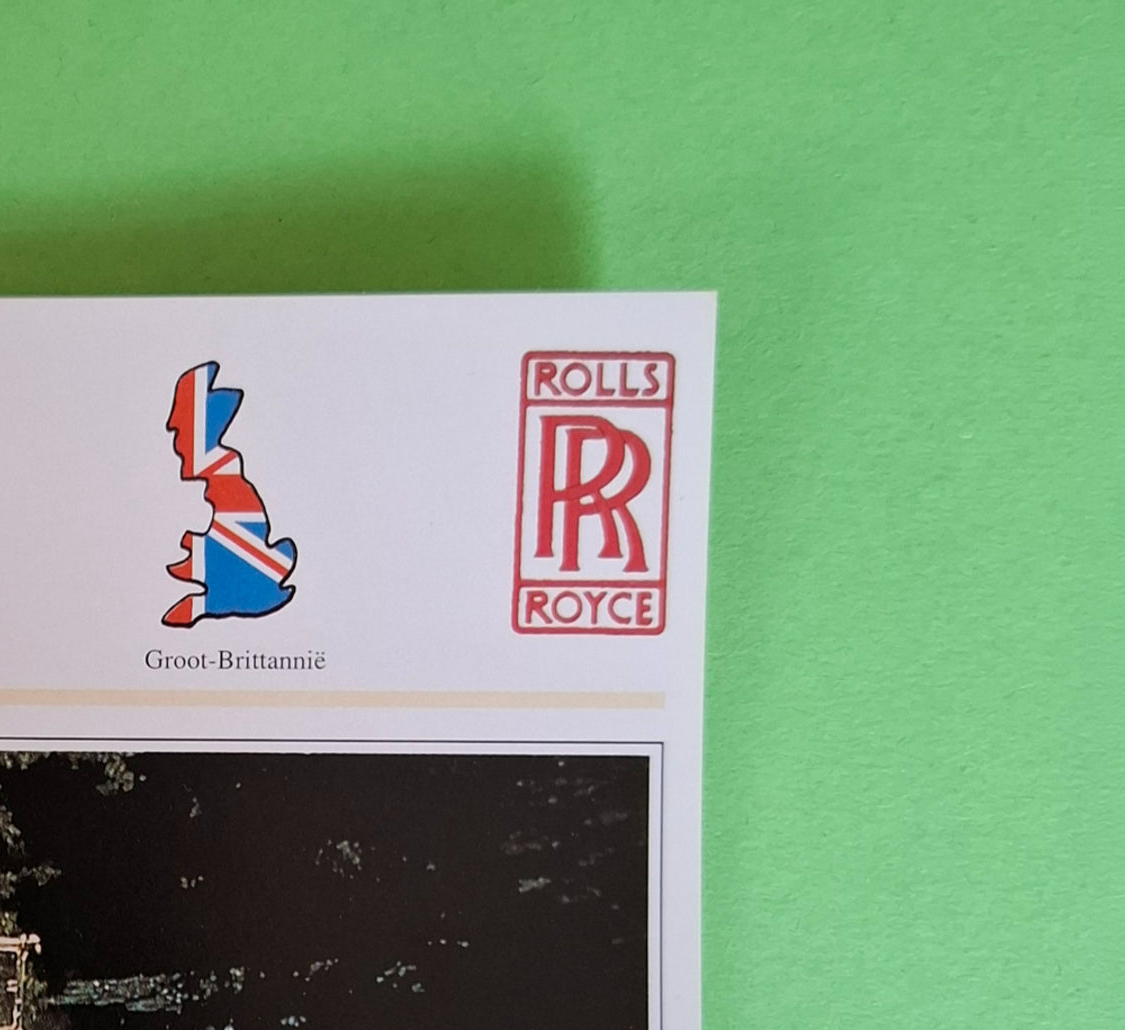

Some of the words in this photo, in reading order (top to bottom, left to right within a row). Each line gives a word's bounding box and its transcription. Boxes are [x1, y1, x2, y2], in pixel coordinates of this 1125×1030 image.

[534, 361, 661, 396] ROLLS
[524, 590, 653, 627] ROYCE
[144, 649, 327, 672] Groot-Brittannië
